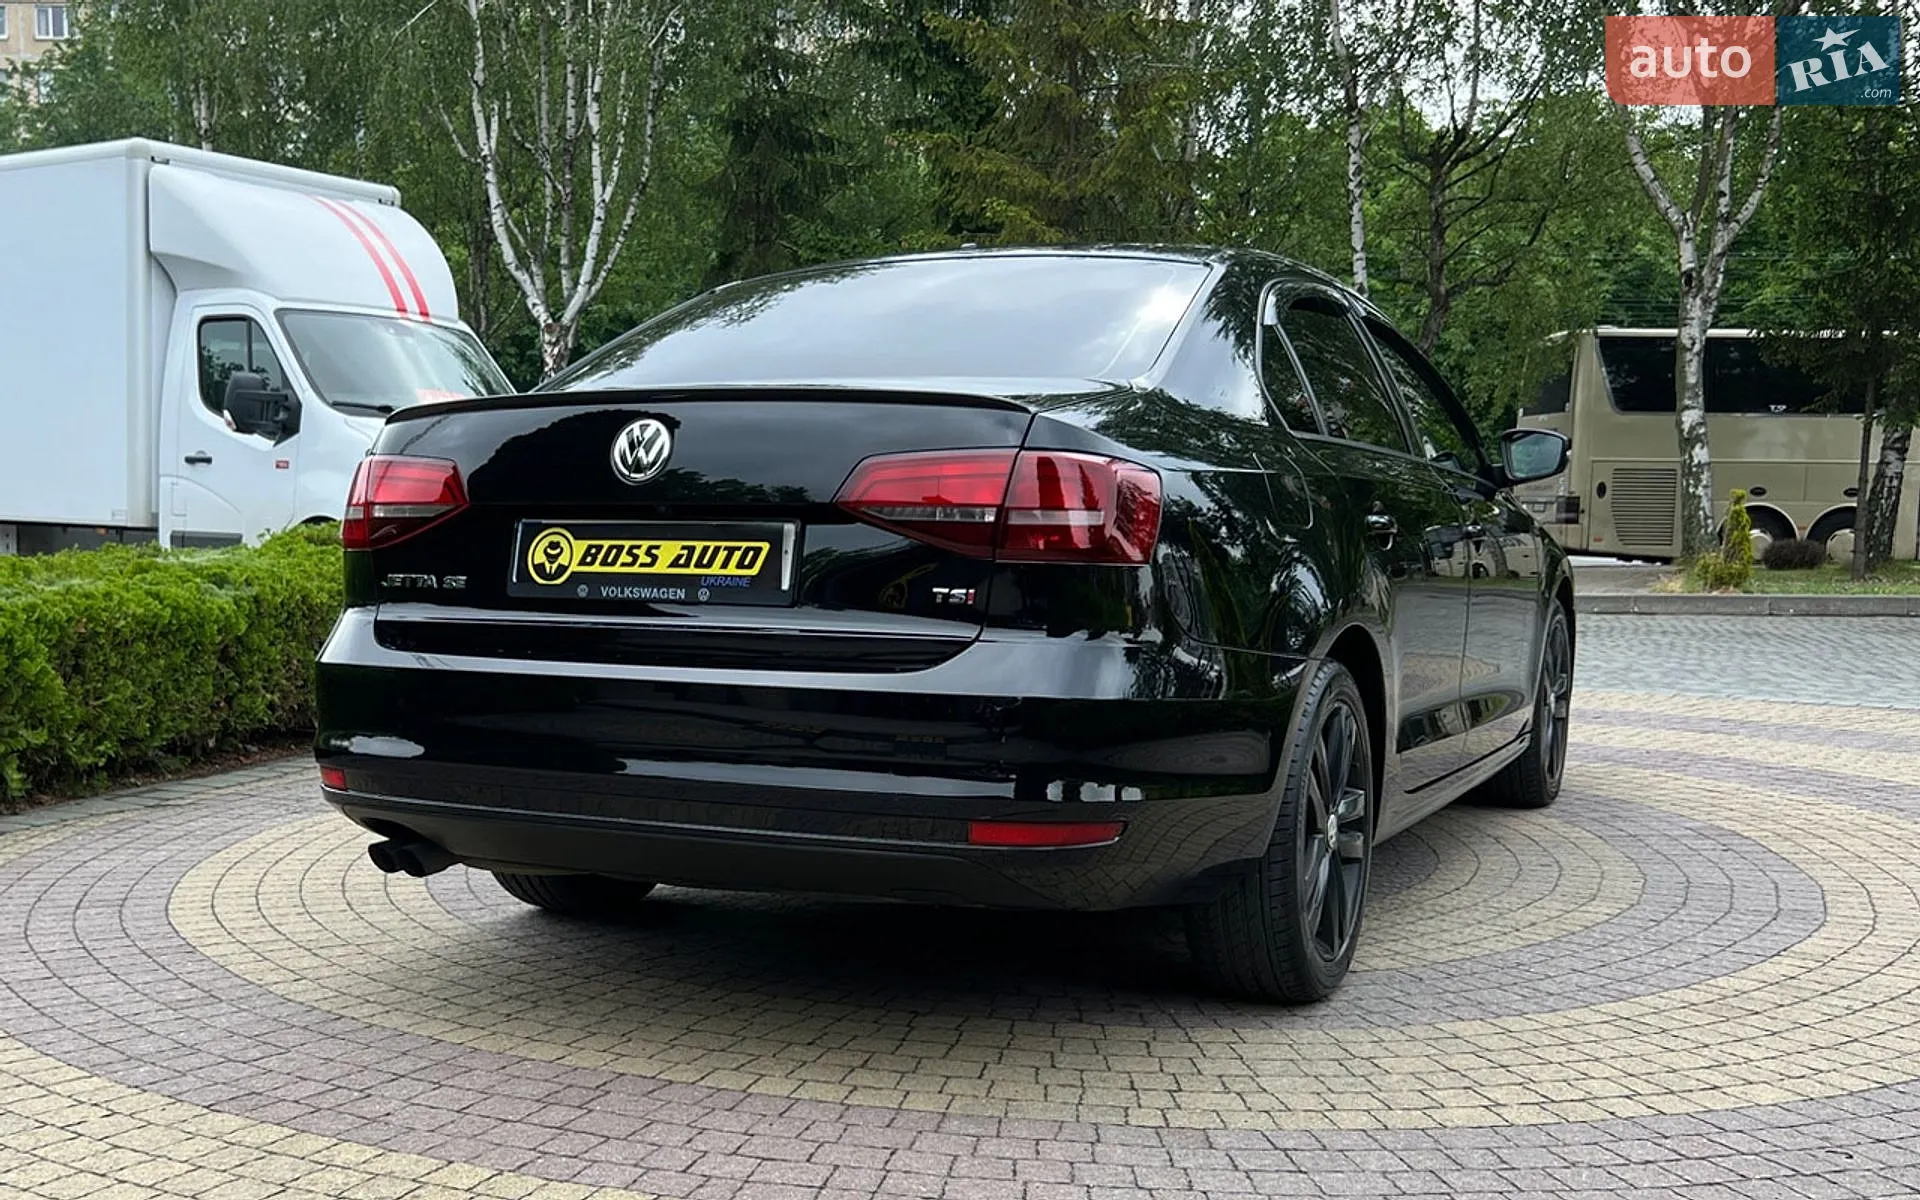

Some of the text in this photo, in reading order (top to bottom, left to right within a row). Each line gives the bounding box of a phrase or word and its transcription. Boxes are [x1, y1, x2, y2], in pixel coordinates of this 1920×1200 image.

[577, 544, 764, 570] BOSS AUTO
[381, 573, 468, 589] JETTA SE
[701, 576, 752, 588] UKRAINE
[600, 586, 686, 600] VOLKSWAGEN
